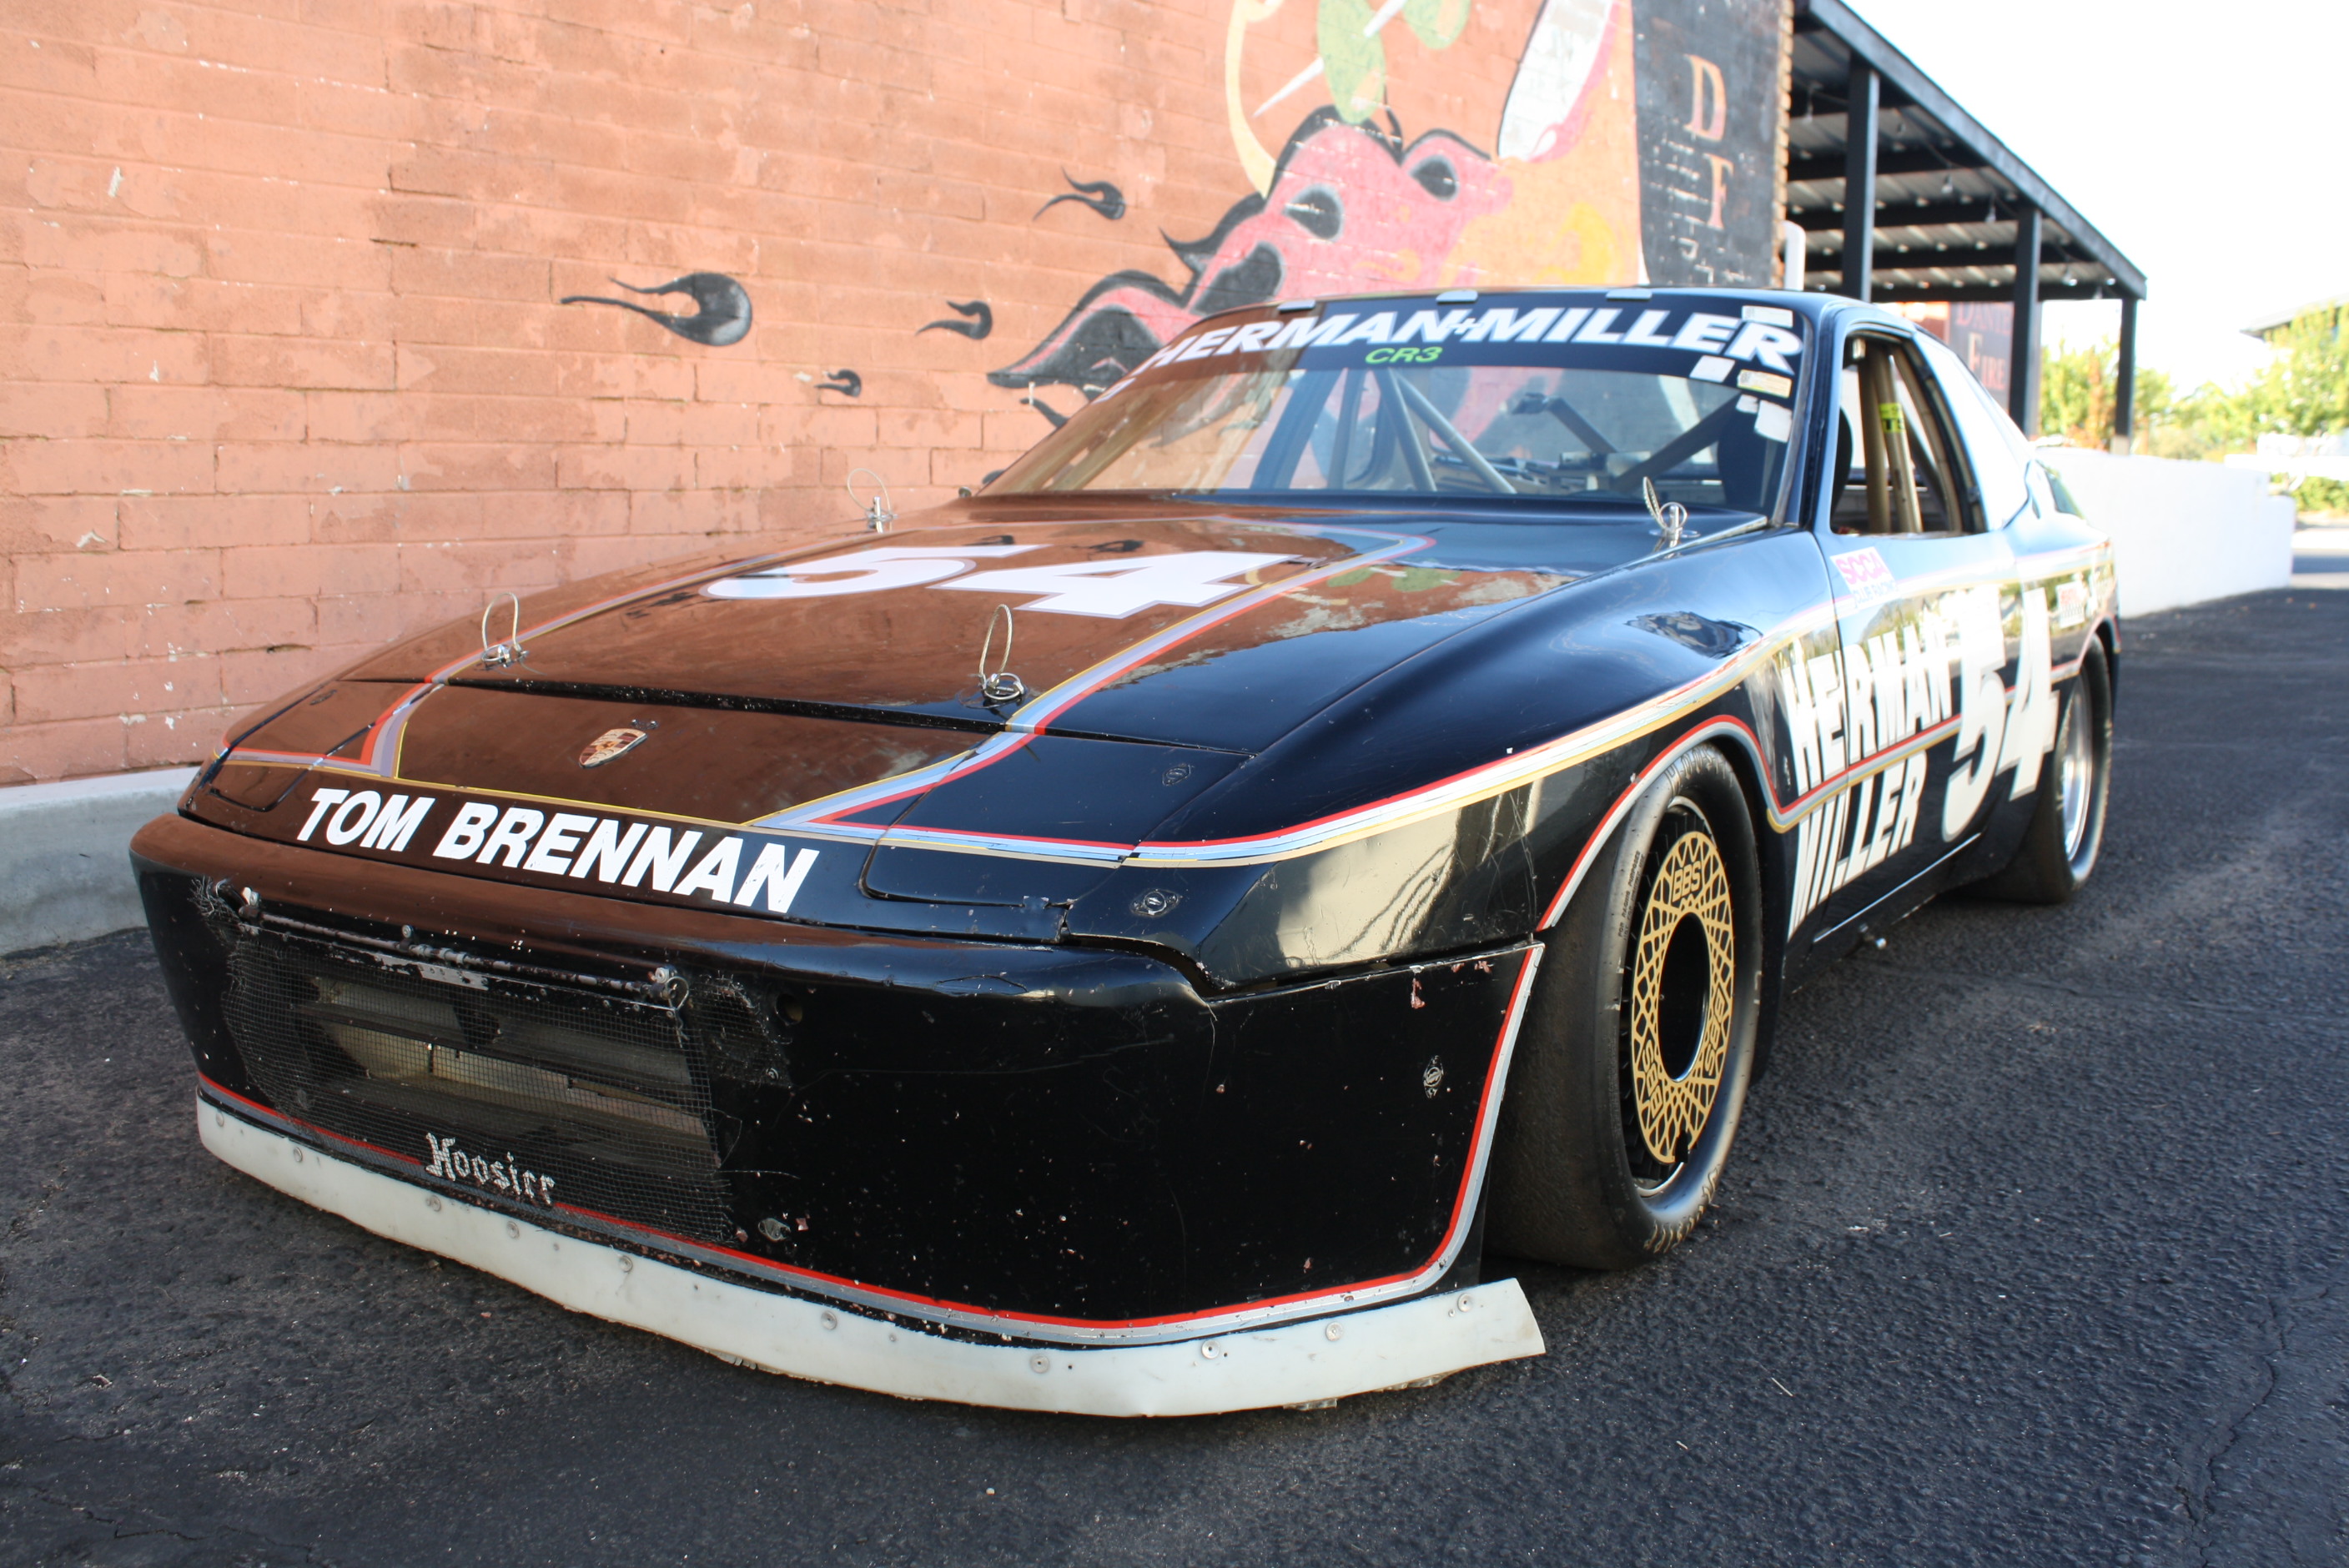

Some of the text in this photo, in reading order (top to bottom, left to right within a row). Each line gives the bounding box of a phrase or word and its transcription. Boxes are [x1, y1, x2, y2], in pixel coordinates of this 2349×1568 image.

[1683, 53, 1727, 142] D
[1365, 345, 1444, 364] CR3
[699, 544, 1303, 619] 54
[1836, 551, 1889, 585] SCCA
[1782, 619, 1953, 797] HERMAN
[1942, 584, 2060, 842] 54
[296, 787, 819, 914] TOM BRENNAN
[1672, 860, 1702, 902] BBS
[1788, 747, 1927, 942] MILLER
[1704, 987, 1727, 1077] BBS
[1642, 1038, 1664, 1118] BBS
